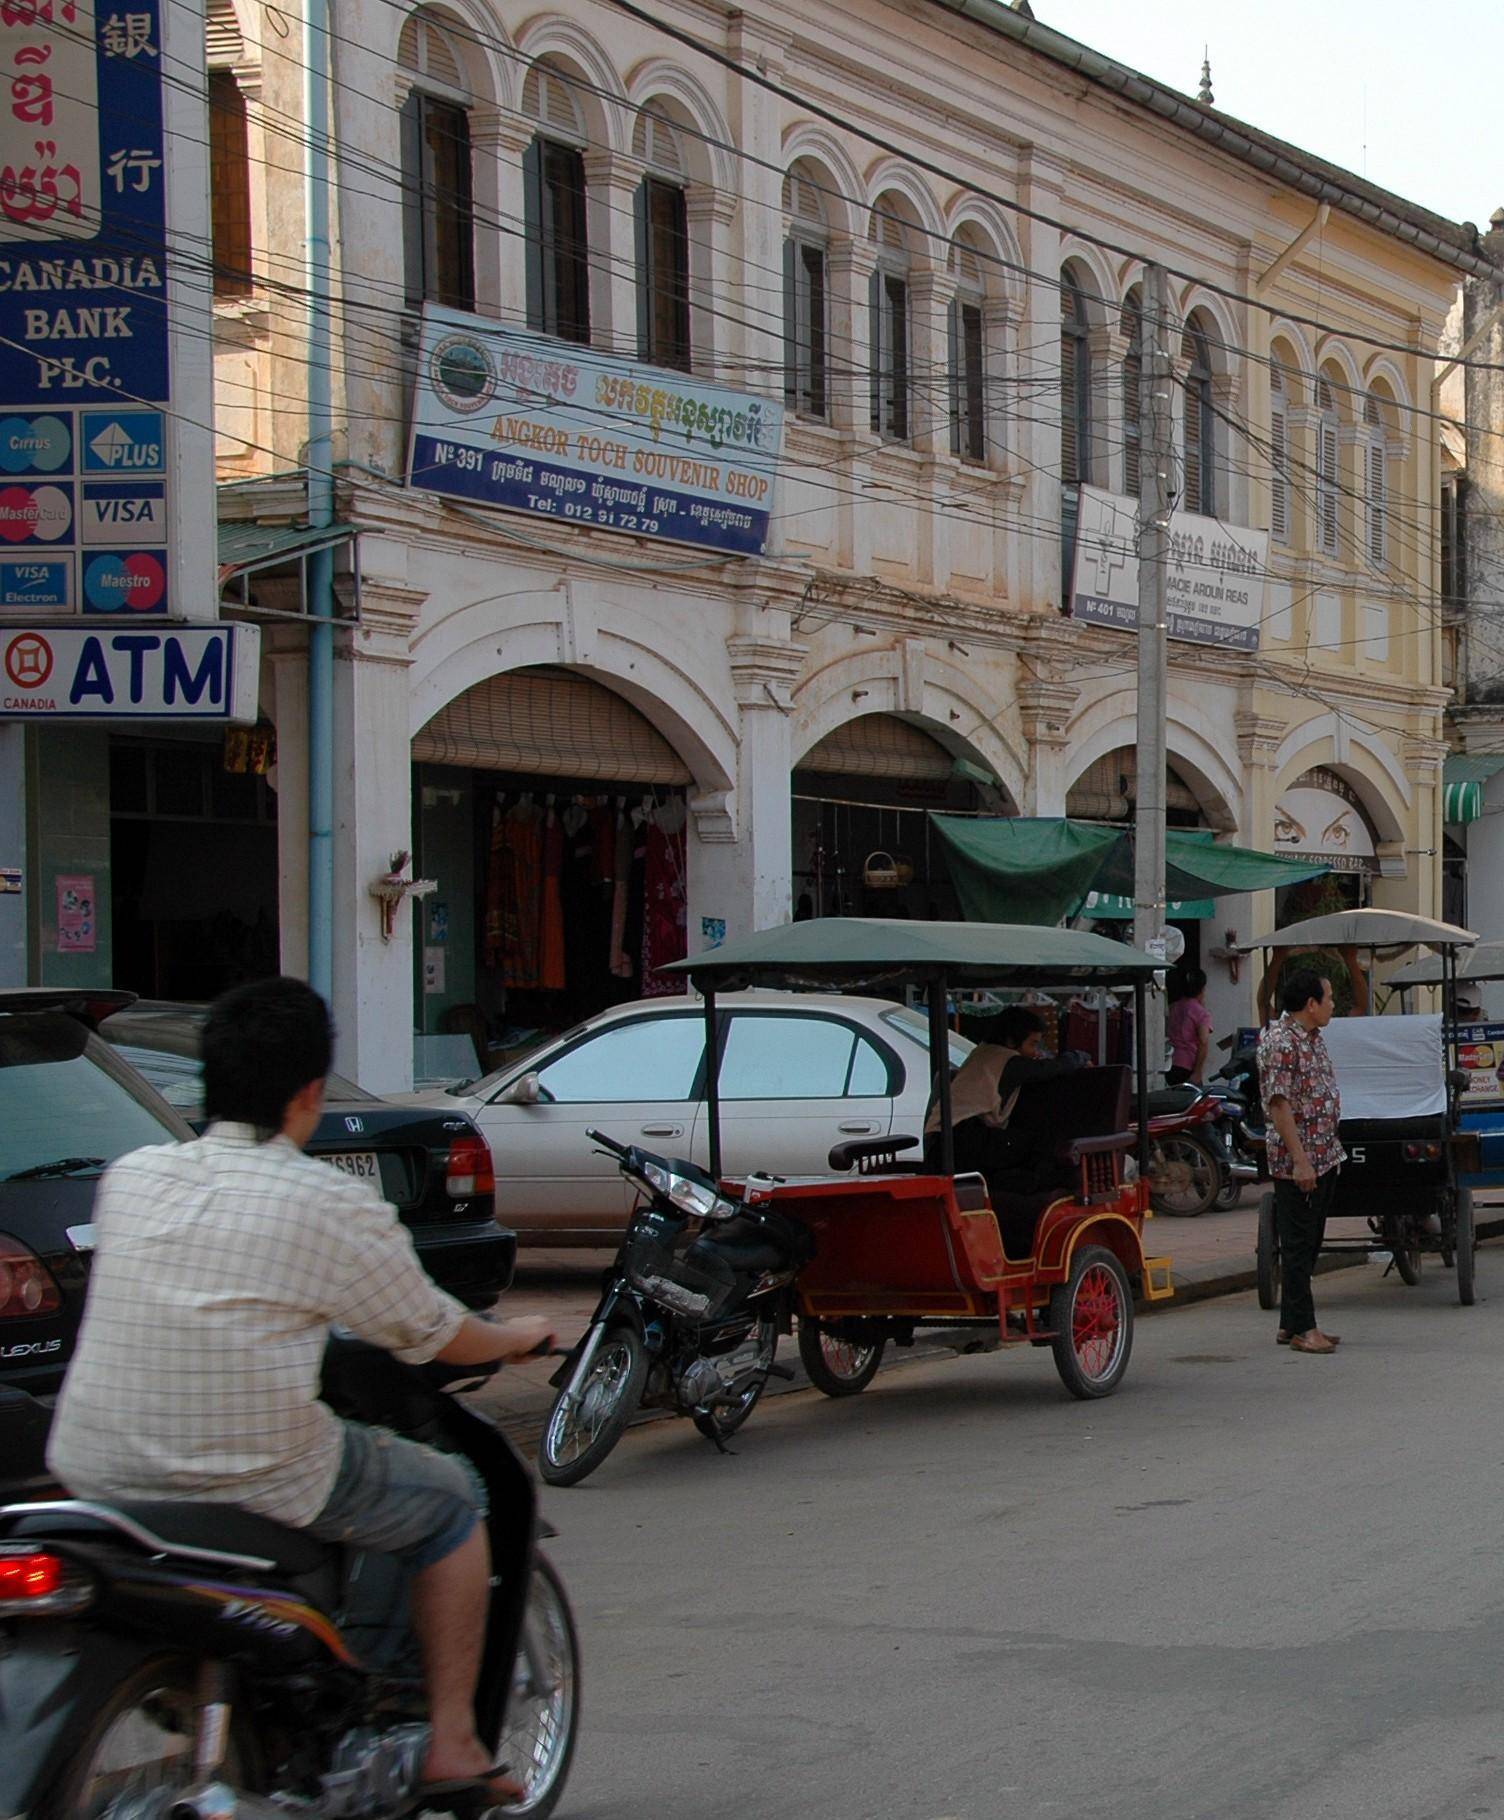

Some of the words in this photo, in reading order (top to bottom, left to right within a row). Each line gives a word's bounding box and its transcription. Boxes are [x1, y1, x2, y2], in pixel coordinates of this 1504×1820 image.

[102, 13, 162, 193] 銀行
[0, 257, 162, 291] CANADIA
[24, 307, 133, 340] BANK
[38, 357, 122, 389] PLC.
[10, 434, 51, 450] Cirrus
[109, 443, 160, 467] PLUS
[456, 447, 484, 473] 391
[490, 415, 569, 457] ANGKOR
[577, 435, 626, 470] TOCH
[633, 449, 720, 490] SOUVENIR
[726, 470, 769, 501] SHOP
[0, 505, 66, 521] MasterCard
[95, 499, 155, 524] VISA
[528, 494, 557, 513] Tel:
[564, 502, 592, 520] 012
[597, 509, 614, 525] 91
[620, 514, 637, 529] 72
[641, 517, 659, 533] 79
[14, 565, 50, 579] VISA
[101, 572, 151, 589] Maestro
[6, 592, 57, 604] Electron
[69, 636, 223, 705] ATM
[4, 698, 57, 712] CANADIA
[0, 1339, 62, 1358] LEXUS
